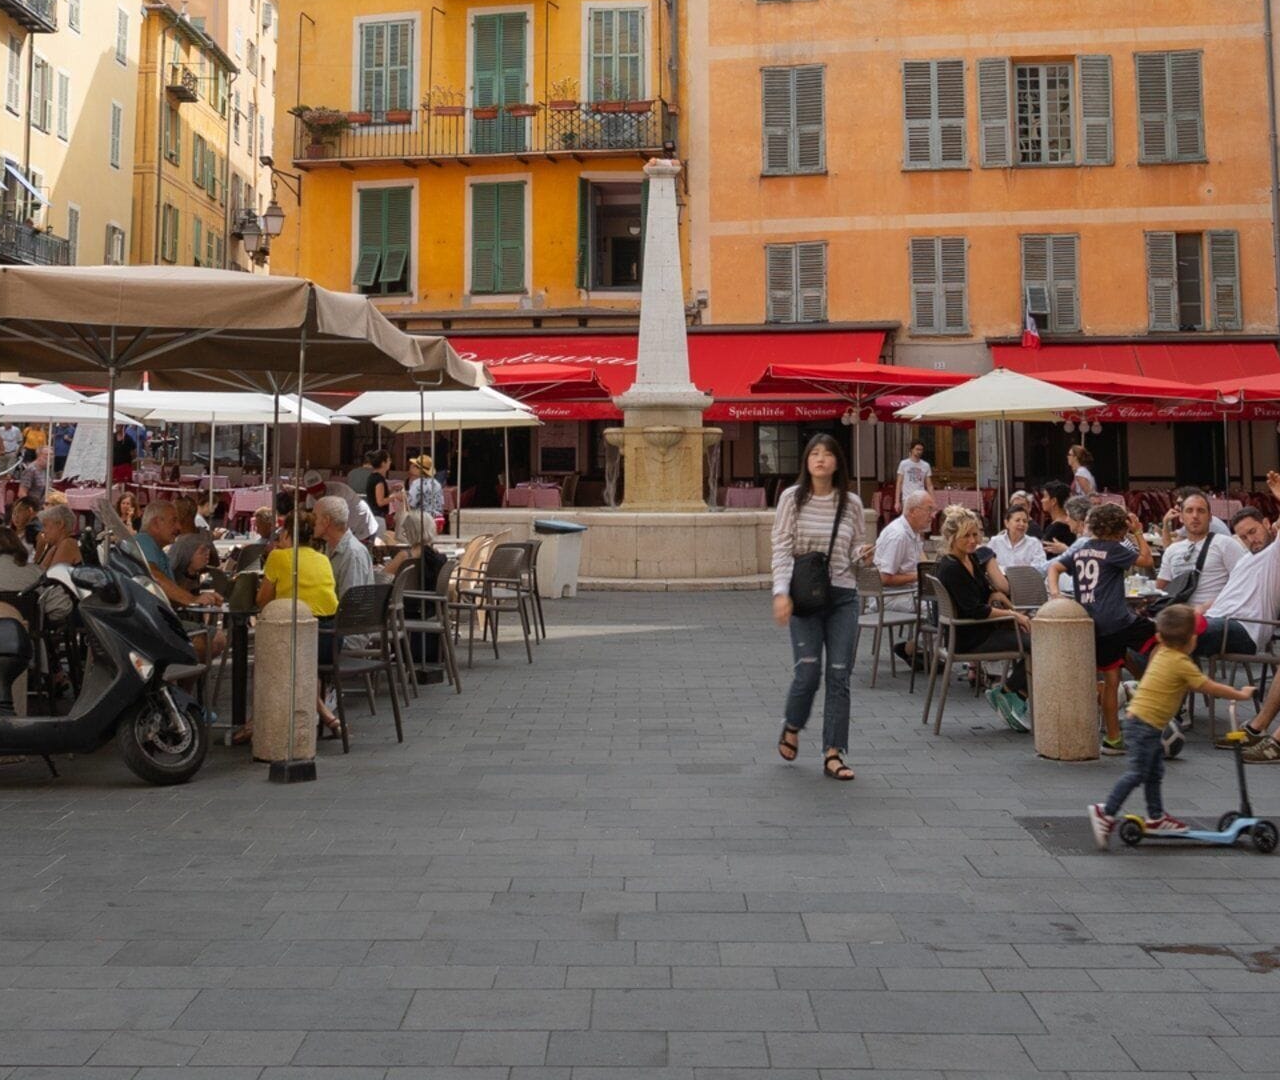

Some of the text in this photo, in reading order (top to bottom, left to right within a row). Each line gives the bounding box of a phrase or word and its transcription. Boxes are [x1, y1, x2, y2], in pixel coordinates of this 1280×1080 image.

[728, 406, 837, 418] Spécialités Niçoises
[1096, 406, 1113, 417] La
[1157, 405, 1214, 417] Fontaine
[1075, 559, 1099, 590] 29
